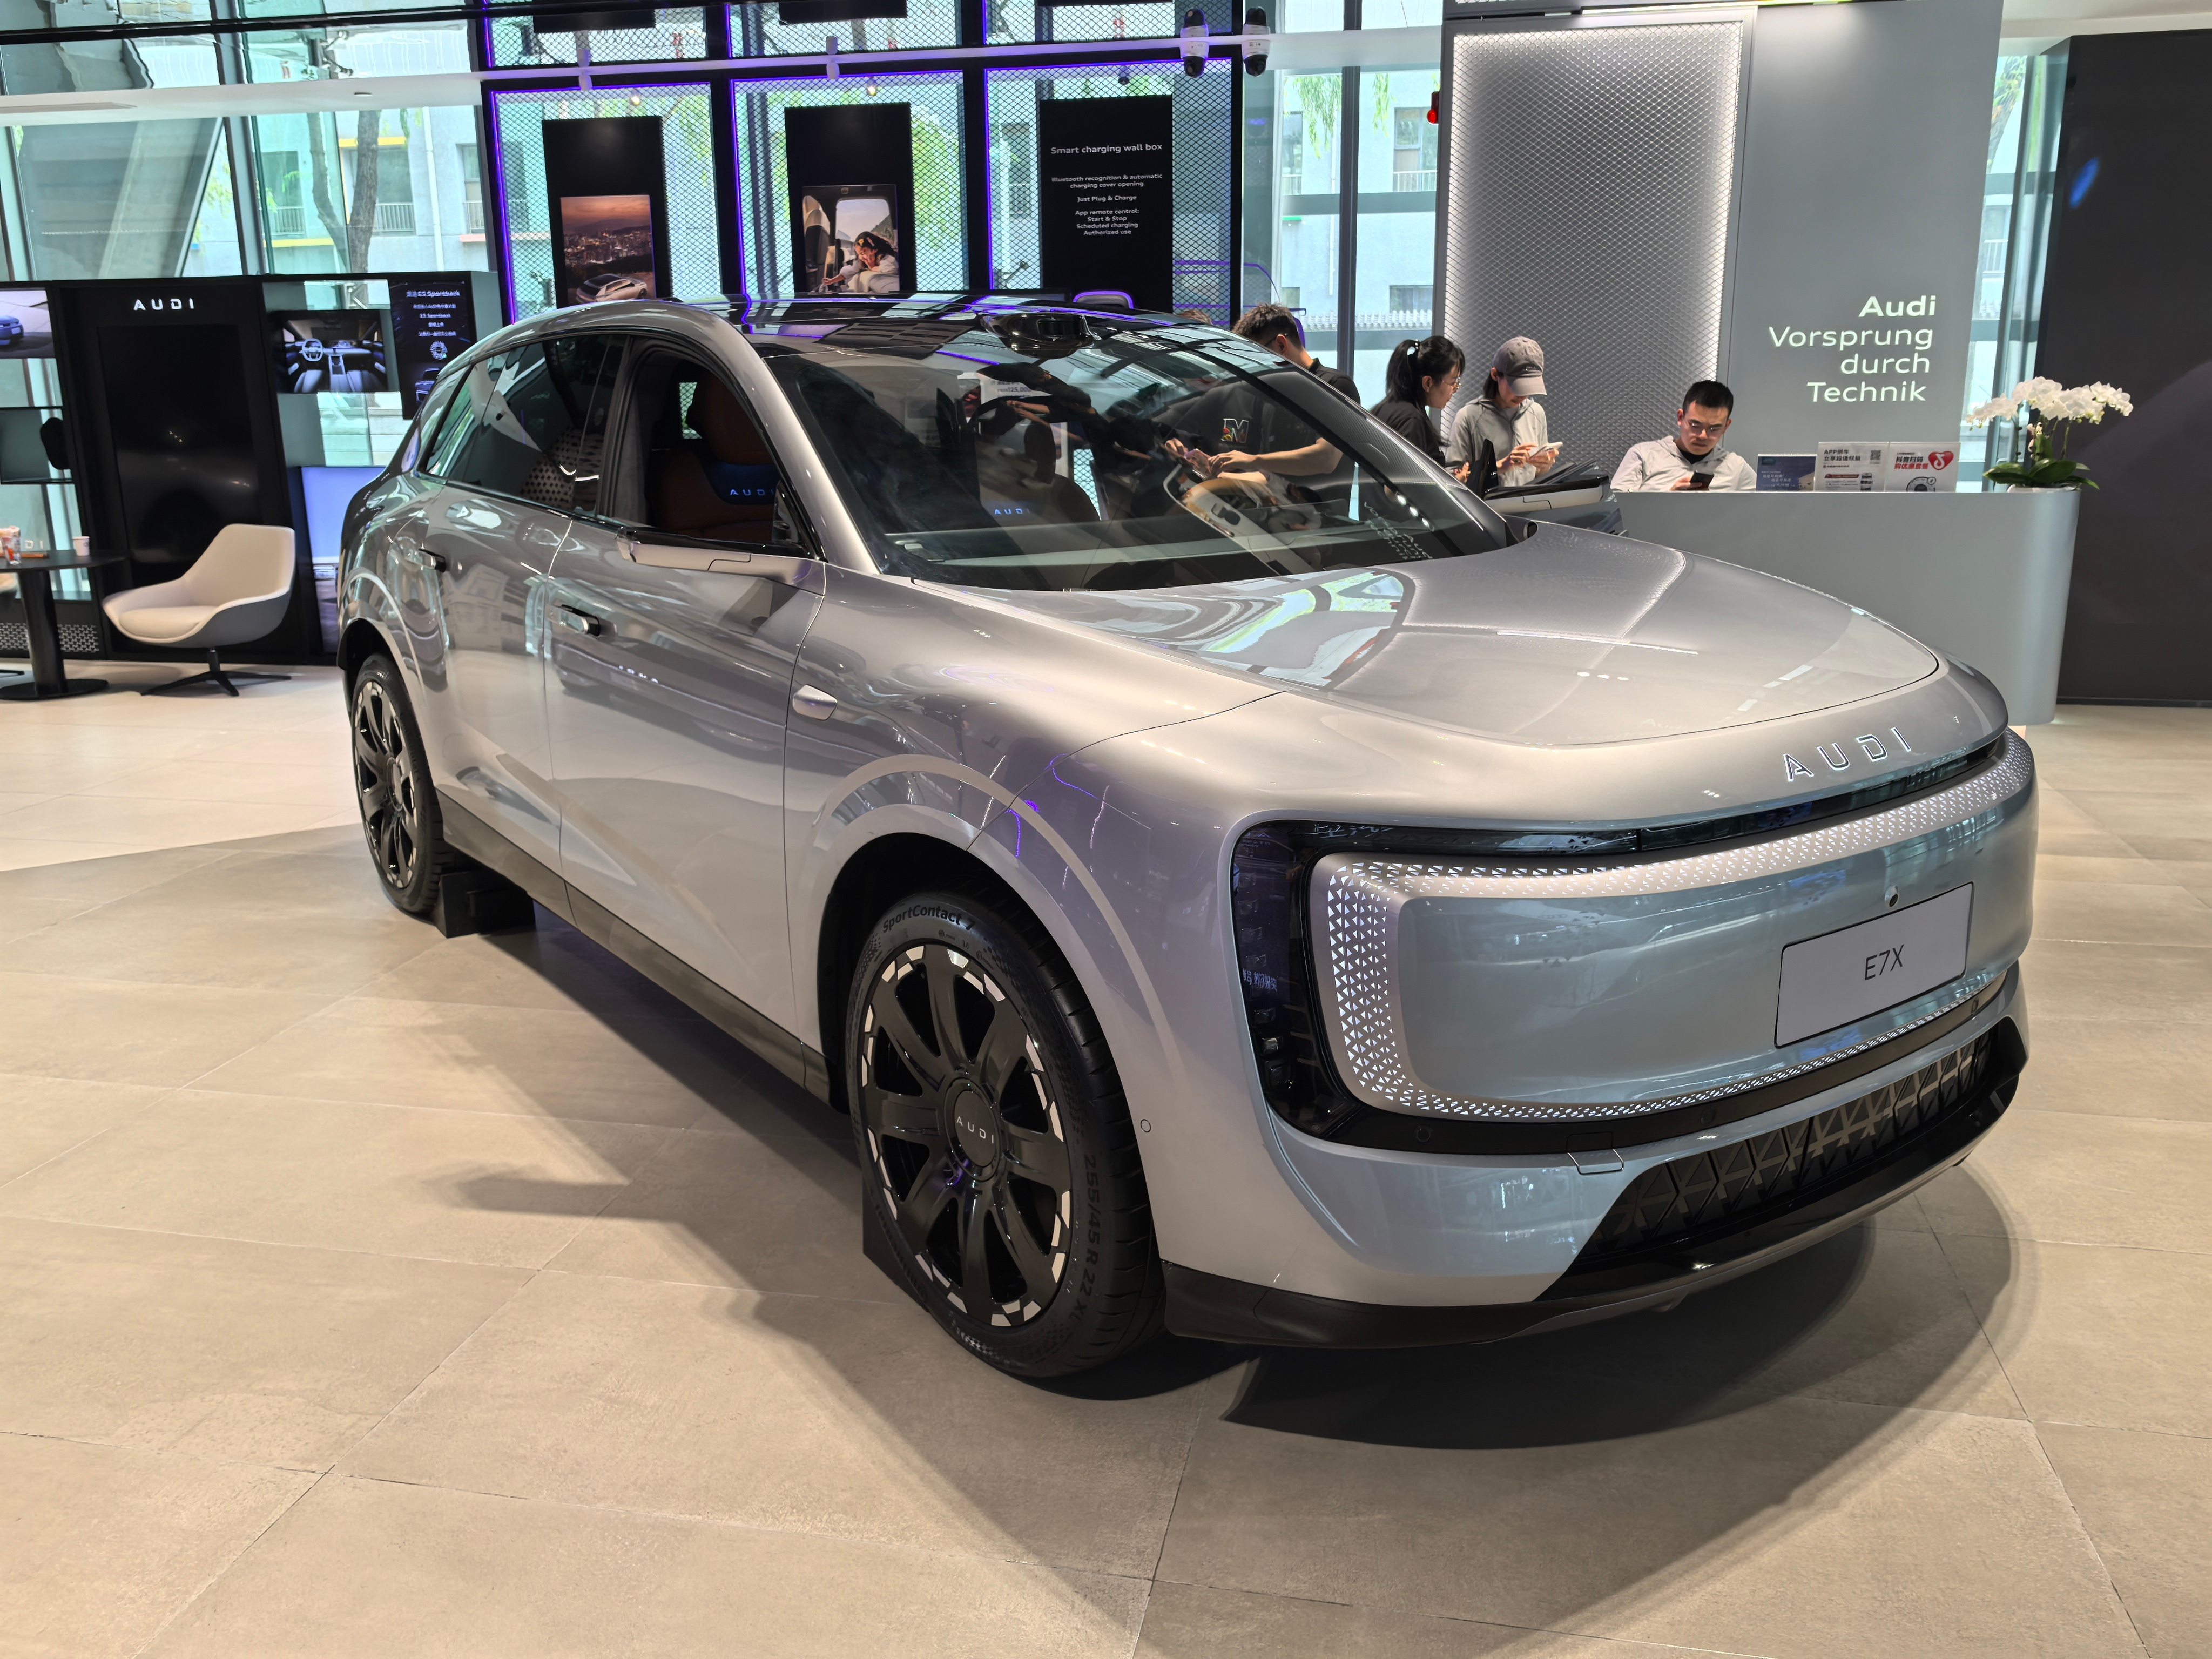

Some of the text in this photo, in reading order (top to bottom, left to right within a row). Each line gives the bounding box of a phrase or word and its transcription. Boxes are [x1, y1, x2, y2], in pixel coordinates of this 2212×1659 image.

[1050, 146, 1080, 154] Smart
[1081, 145, 1121, 153] charging
[133, 298, 194, 311] AUDI
[1858, 295, 1936, 318] Audi
[1769, 326, 1933, 351] Vorsprung
[1840, 352, 1930, 374] durch
[1807, 380, 1926, 402] Technik
[1783, 727, 1912, 782] AUDI
[883, 905, 975, 933] SportContact 7
[1864, 944, 1904, 981] E7X
[956, 1116, 994, 1144] AUDI
[1084, 1154, 1101, 1244] 255/45
[1085, 1248, 1098, 1265] R
[1080, 1269, 1096, 1296] 22
